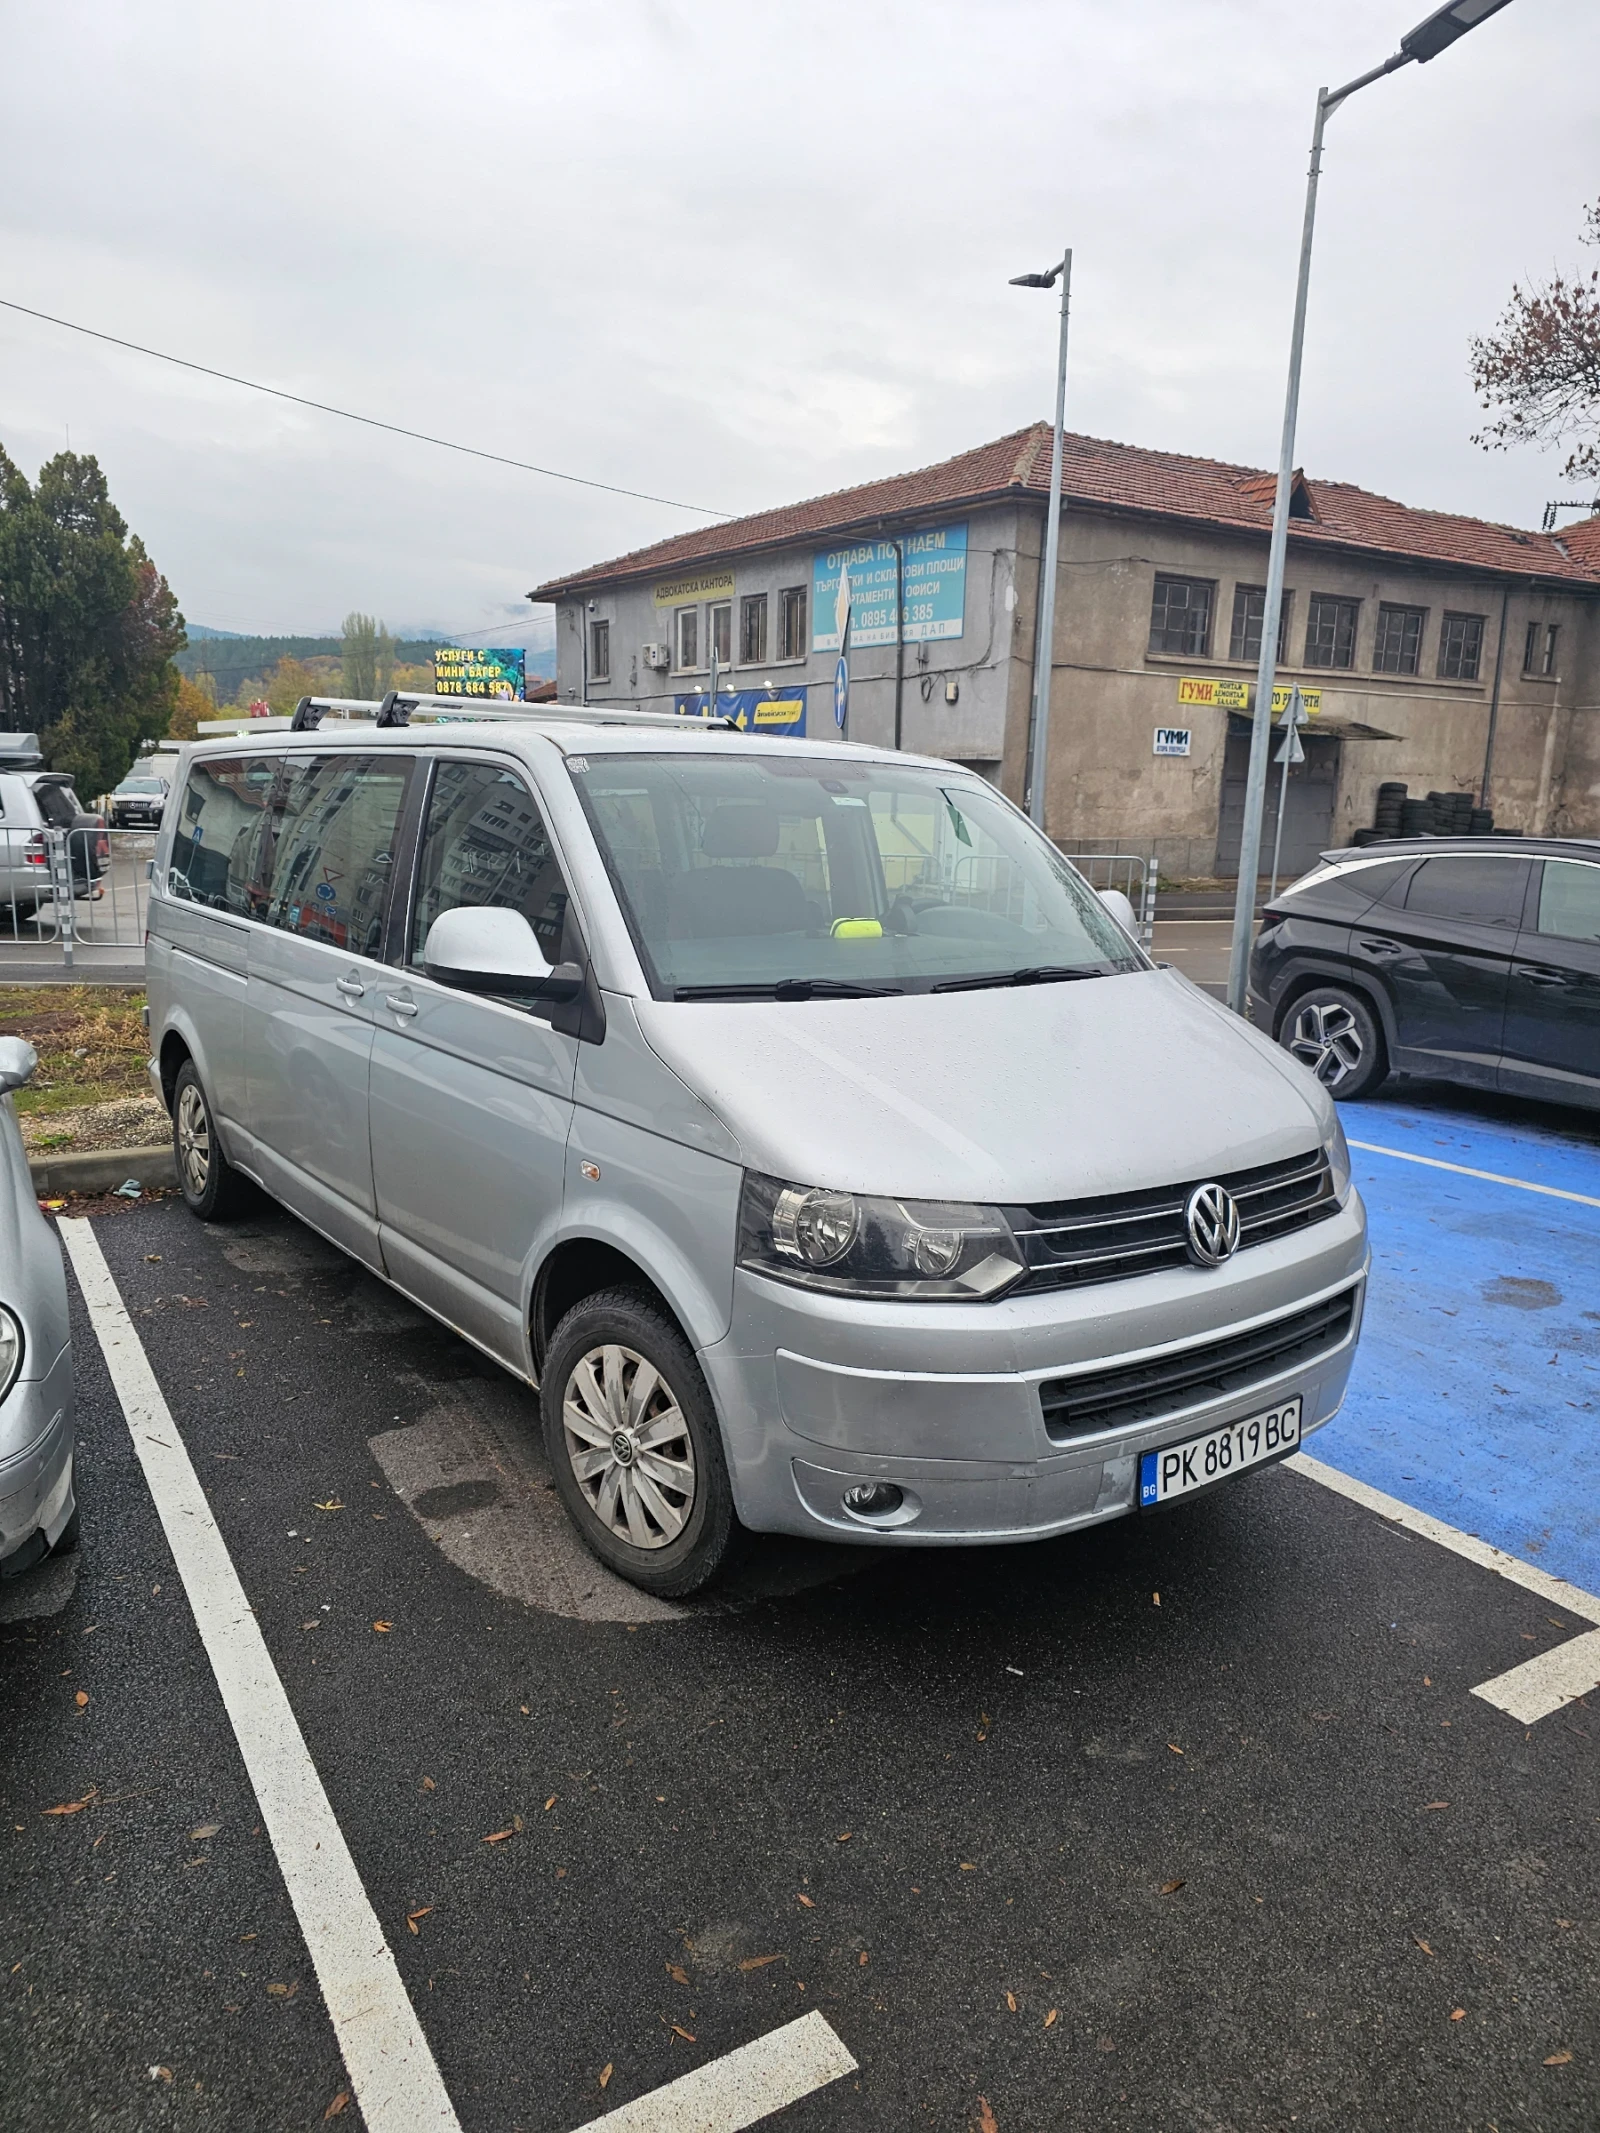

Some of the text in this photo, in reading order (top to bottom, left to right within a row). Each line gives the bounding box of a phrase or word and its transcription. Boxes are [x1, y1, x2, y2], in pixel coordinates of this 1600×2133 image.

[827, 532, 945, 570] ОТДАВА ПОД НАЕМ
[816, 556, 964, 593] ТЪРГОКИ И СКЛАОВИ ПЛОЩИ
[656, 575, 733, 600] АДВОКАТСКА КАНТОРА
[905, 581, 940, 598] ОФИСИ
[861, 610, 886, 628] 0895
[889, 606, 909, 624] 46
[912, 603, 933, 620] 385
[880, 629, 914, 640] БИВИЯ
[921, 623, 945, 637] ДАП
[477, 650, 485, 661] С
[436, 666, 501, 678] МИНИ БАГЕР
[437, 681, 507, 693] 0878 684 587
[1181, 682, 1213, 701] ГУМИ
[1219, 682, 1242, 690] МОНТАЖ
[1213, 690, 1245, 699] ДЕМОНТАЖ
[1217, 697, 1240, 706] БАЛАНС
[1157, 730, 1188, 745] ГУМИ
[1163, 1407, 1295, 1493] PK 8819 BC
[1143, 1484, 1156, 1498] BG
